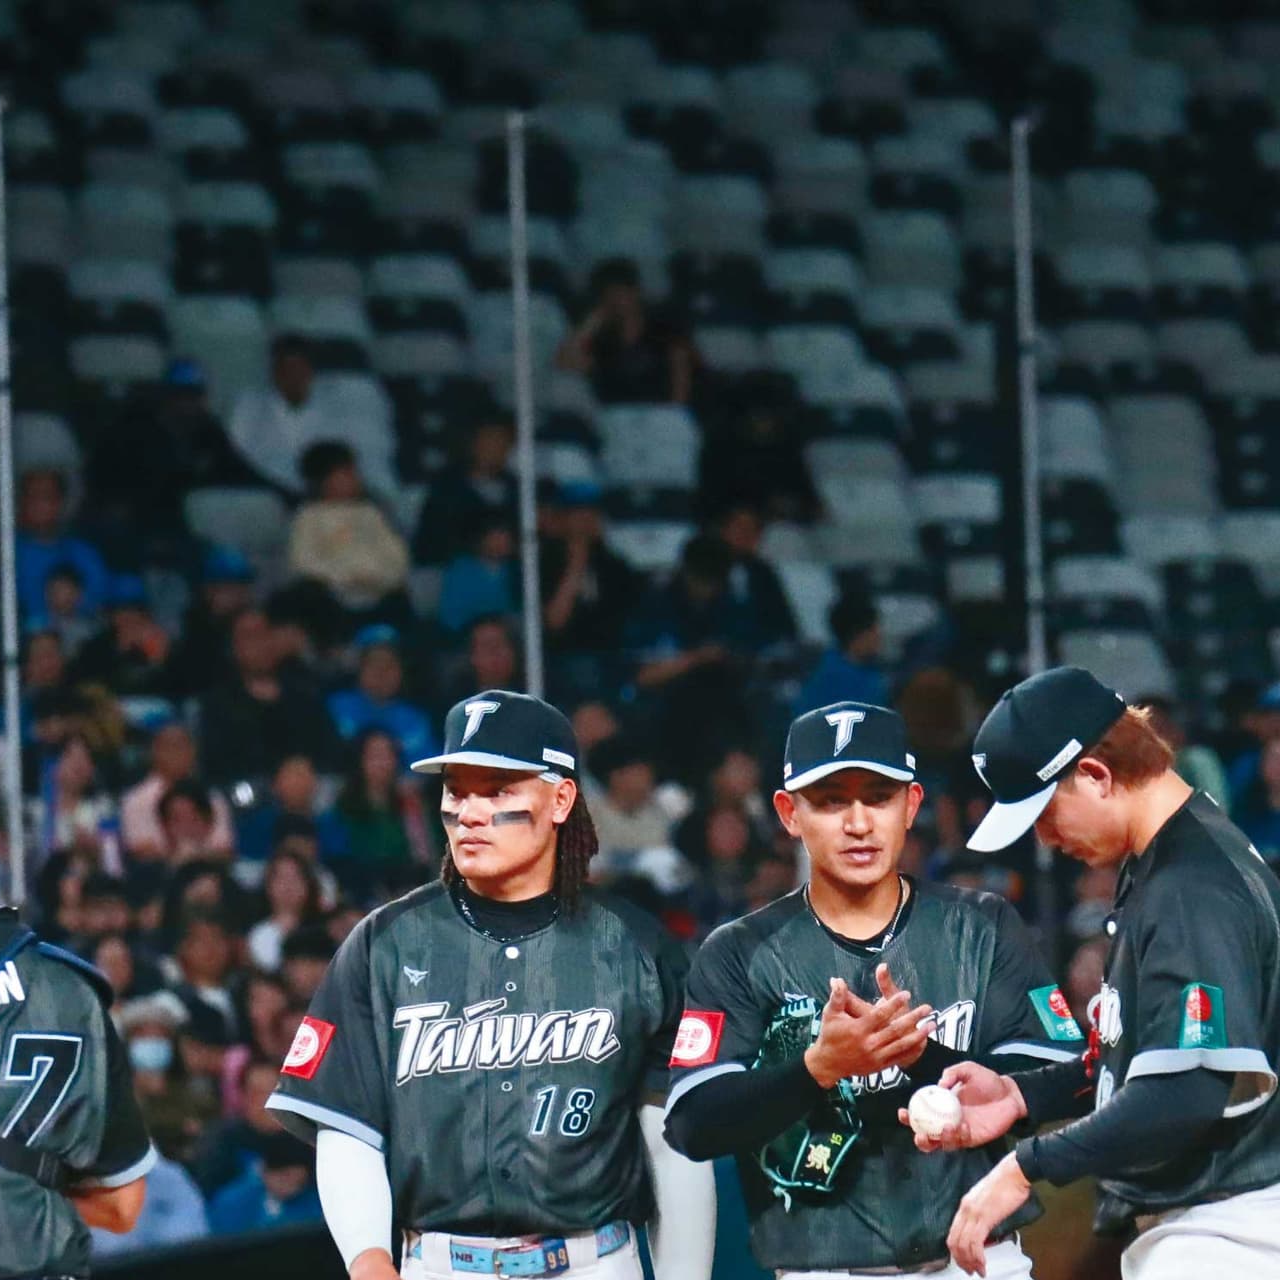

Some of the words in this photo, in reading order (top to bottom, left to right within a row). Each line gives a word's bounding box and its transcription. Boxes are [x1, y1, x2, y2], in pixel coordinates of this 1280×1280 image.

[460, 700, 501, 747] T
[824, 710, 866, 757] T
[393, 997, 621, 1087] Taiwan
[530, 1083, 596, 1137] 18
[546, 1247, 568, 1270] 99
